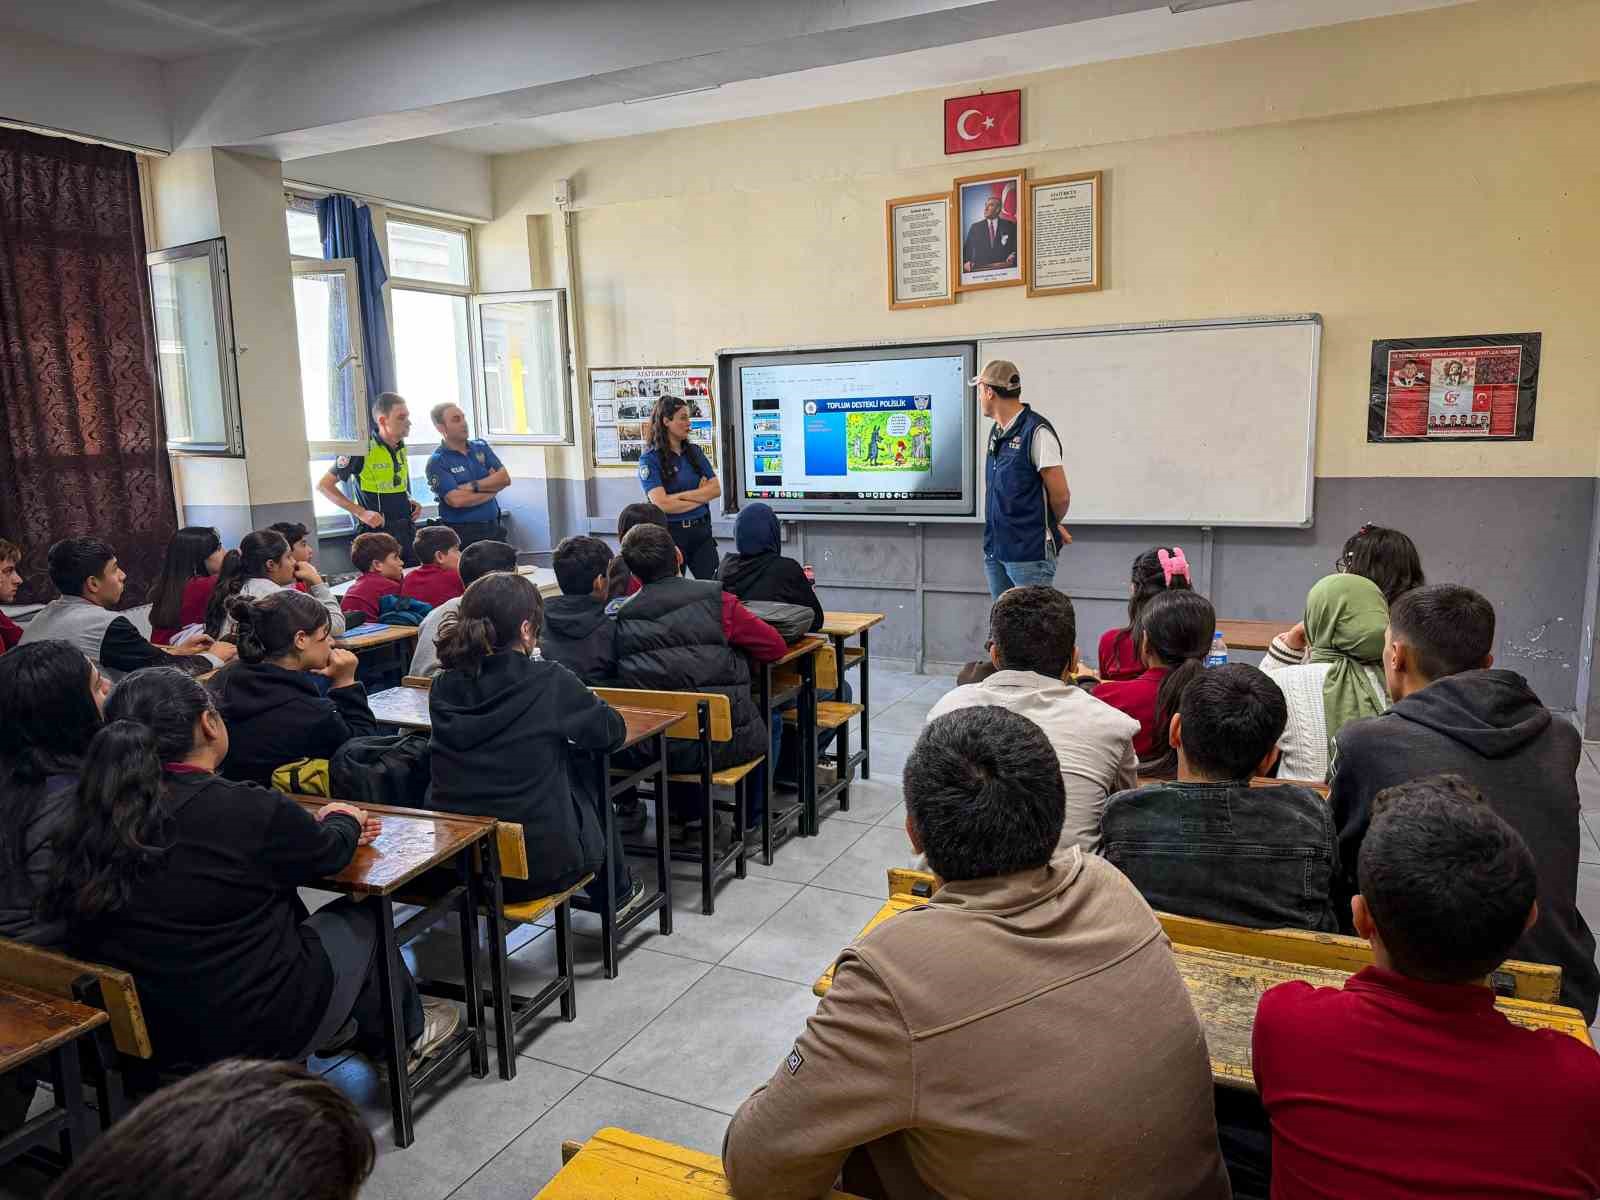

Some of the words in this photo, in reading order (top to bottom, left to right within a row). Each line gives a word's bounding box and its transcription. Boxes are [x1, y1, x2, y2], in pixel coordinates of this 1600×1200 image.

[827, 401, 850, 409] TOPLUM
[851, 400, 879, 409] DESTEKLİ
[879, 399, 906, 408] POLİSLİK
